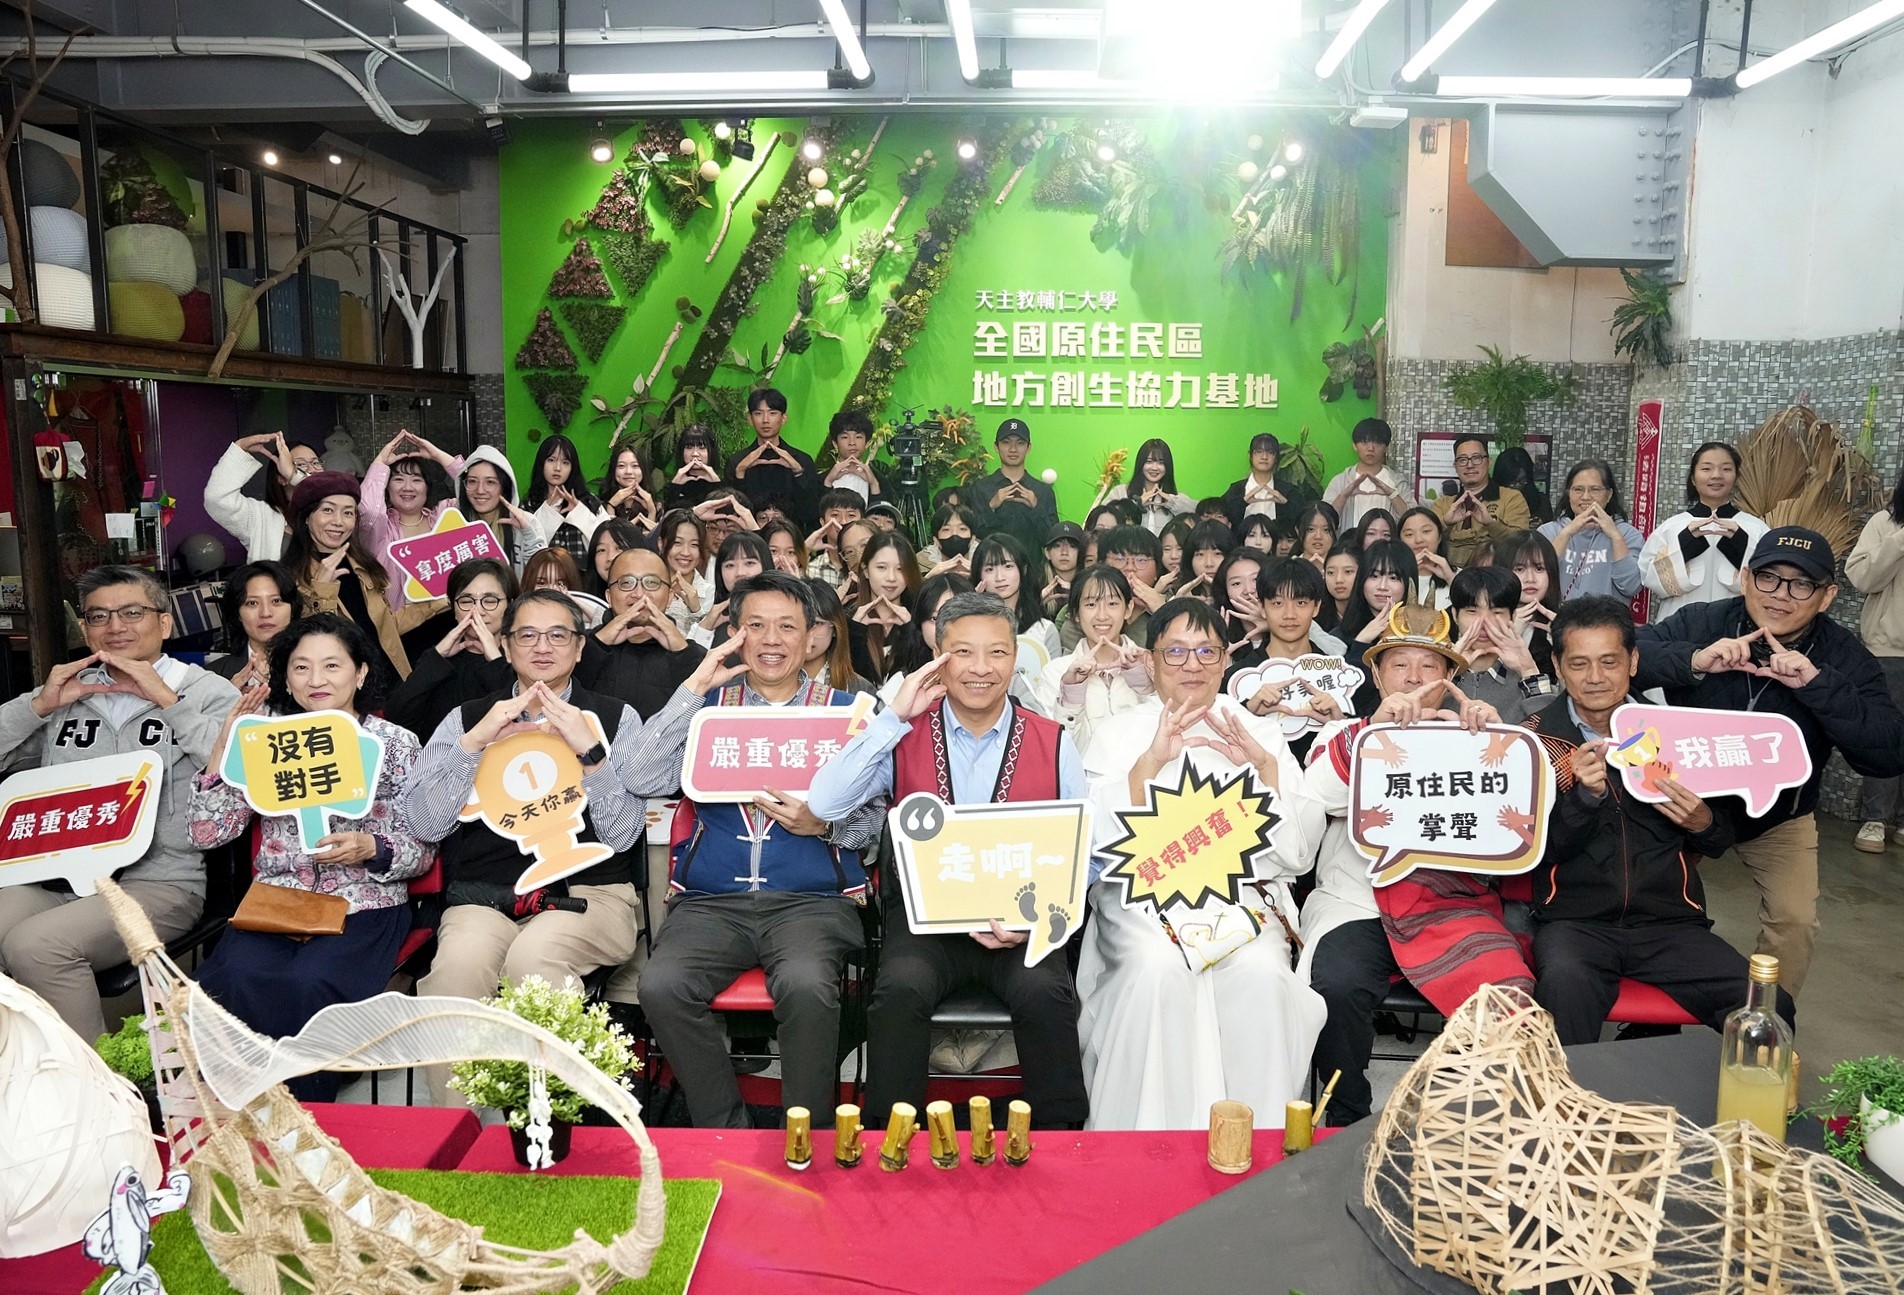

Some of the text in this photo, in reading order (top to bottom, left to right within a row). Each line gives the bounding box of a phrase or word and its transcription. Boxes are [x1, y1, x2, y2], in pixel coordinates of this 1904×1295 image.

[975, 289, 1118, 311] 天主教輔仁大學
[973, 321, 1203, 358] 全國原住民區
[971, 370, 1279, 409] 地方創生協力基地
[1776, 536, 1812, 550] FJCU
[1299, 658, 1342, 671] WOW!
[267, 726, 335, 765] 沒有
[708, 736, 842, 769] 嚴重優秀
[1674, 732, 1783, 769] 我贏了
[273, 762, 341, 802] 對手
[519, 760, 539, 791] 1
[1385, 771, 1508, 799] 原住民的
[7, 800, 121, 841] 嚴重優秀
[499, 785, 582, 829] 今天你贏
[1136, 800, 1249, 887] 覺得興奮！
[1418, 812, 1478, 842] 掌聲
[937, 841, 1066, 884] 走啊～
